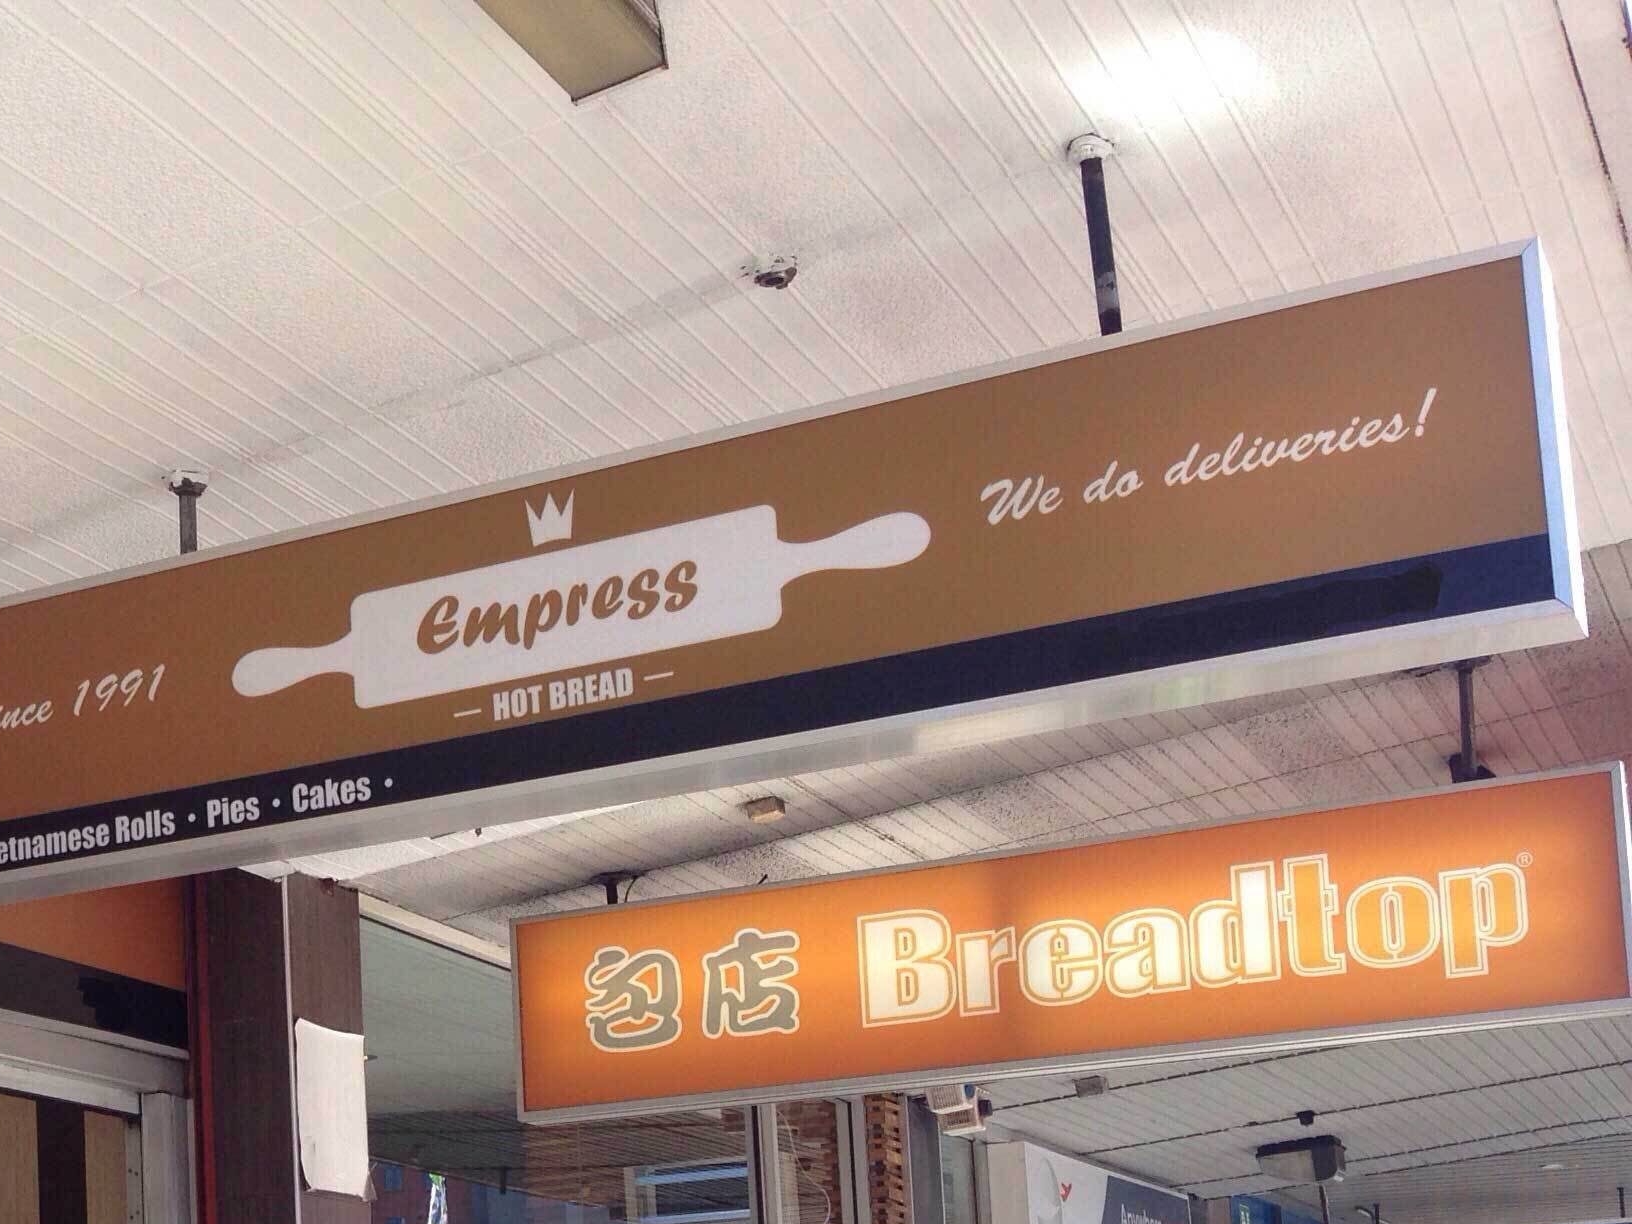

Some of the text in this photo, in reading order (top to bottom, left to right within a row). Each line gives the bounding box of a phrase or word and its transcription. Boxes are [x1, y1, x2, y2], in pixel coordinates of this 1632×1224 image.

[980, 387, 1438, 527] We do deliveries!
[416, 559, 699, 655] Empress
[72, 663, 169, 718] 1991
[492, 667, 634, 722] HOT BREAD
[115, 806, 176, 844] Rolls
[207, 792, 260, 828] Pies
[292, 773, 371, 814] Cakes
[856, 853, 1531, 1028] Breadtop
